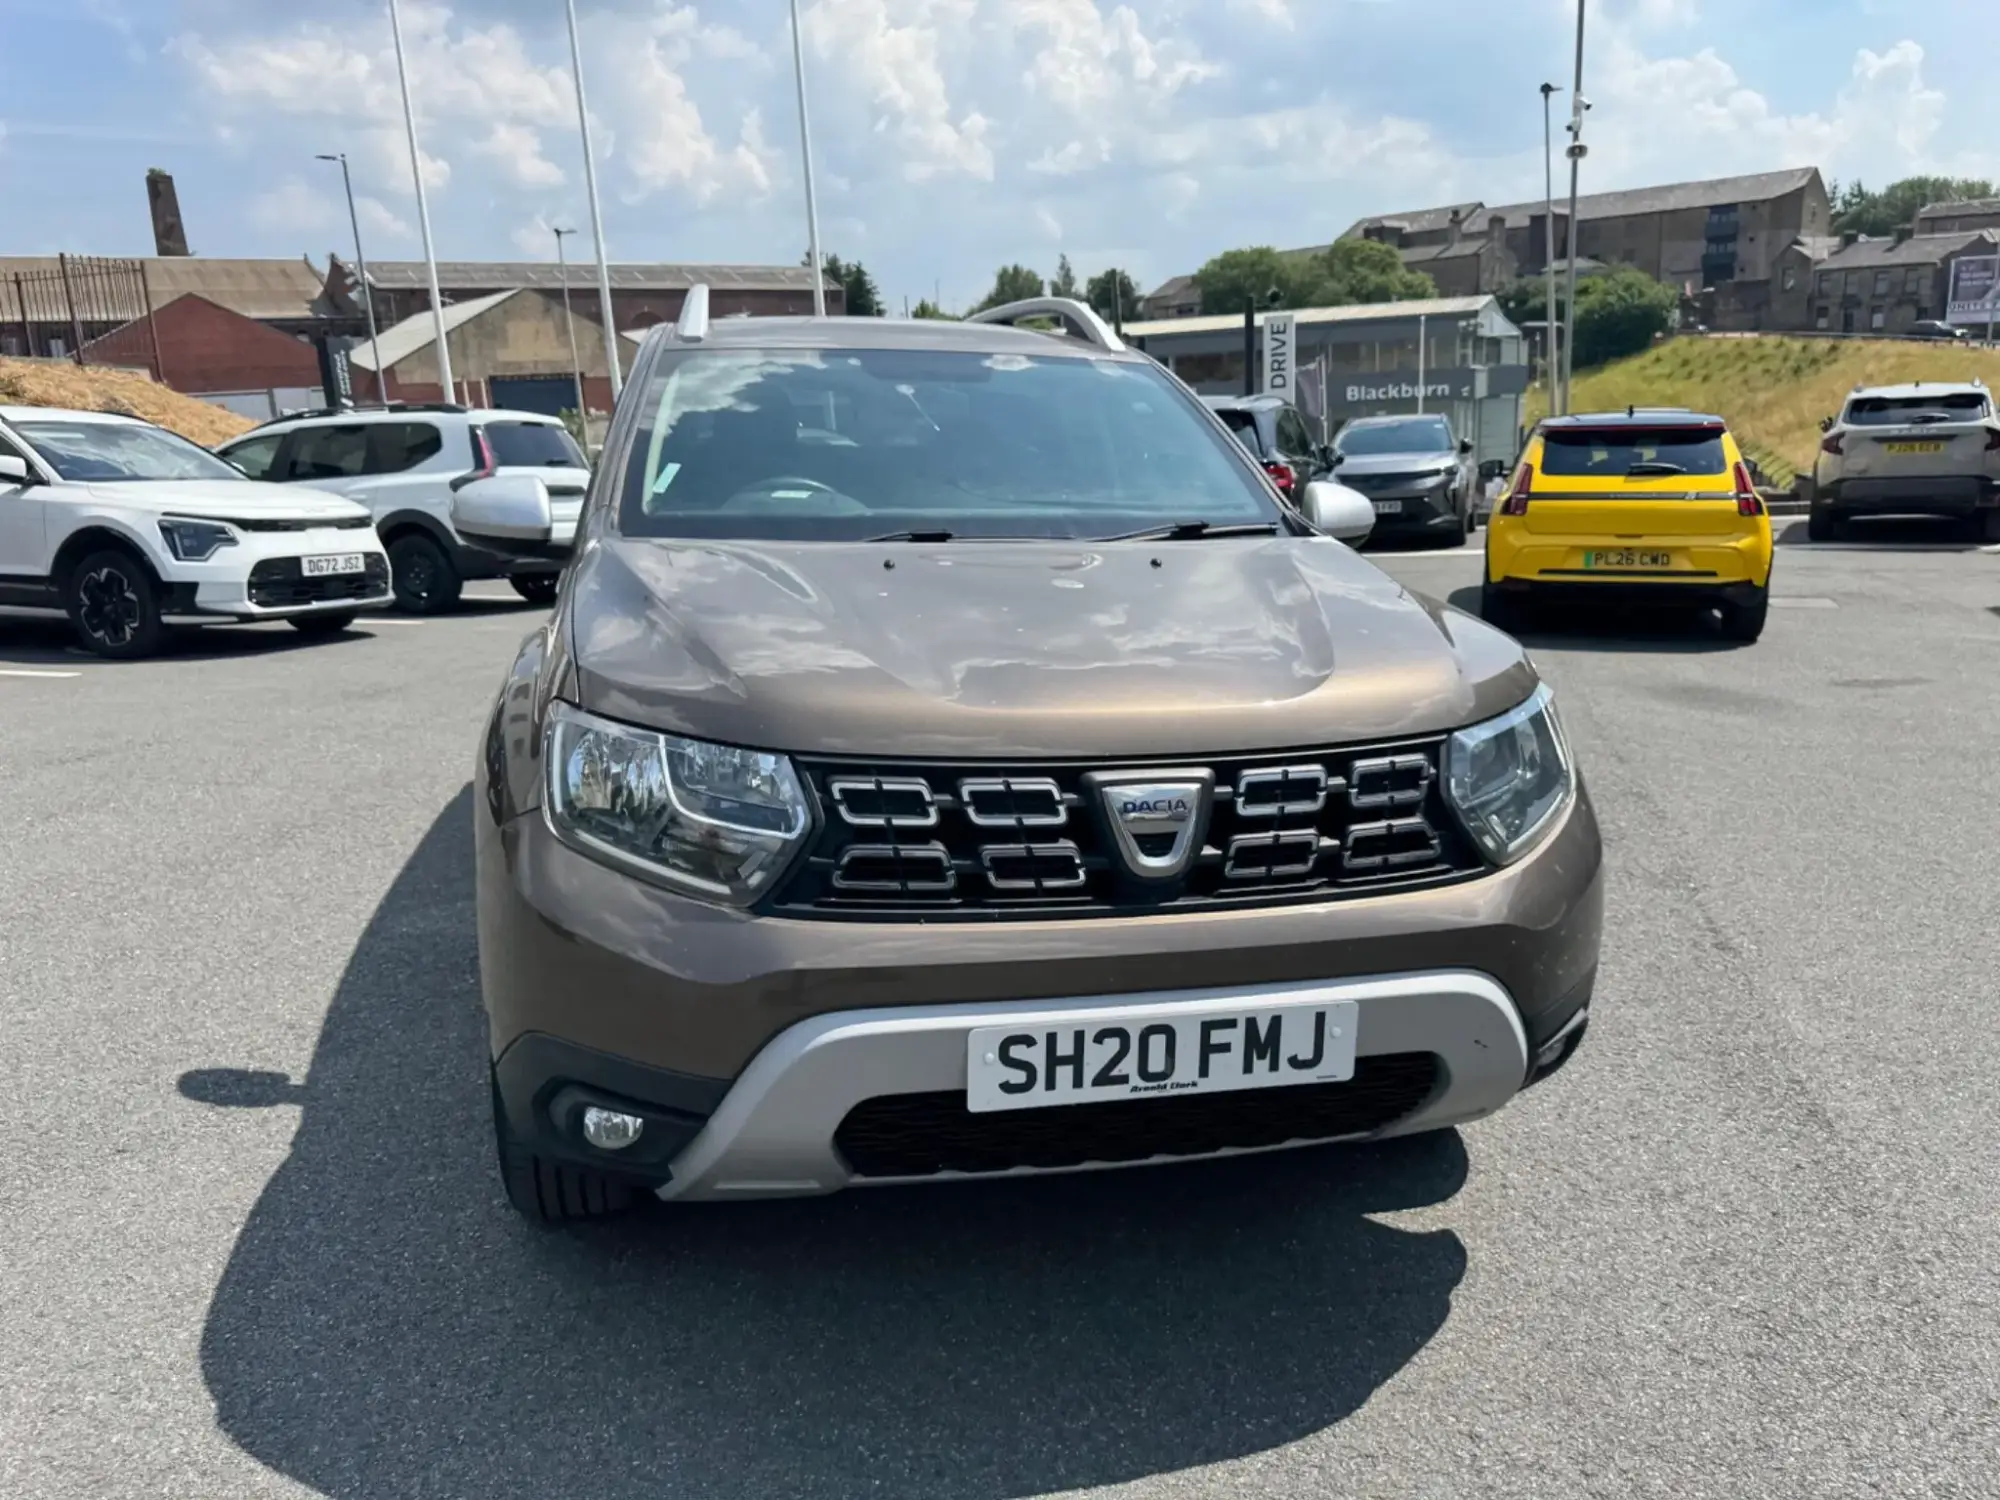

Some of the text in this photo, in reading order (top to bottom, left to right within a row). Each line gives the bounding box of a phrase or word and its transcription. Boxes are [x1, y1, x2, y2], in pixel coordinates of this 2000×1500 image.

[1270, 322, 1287, 390] DRIVE
[1346, 383, 1450, 401] Blackburn
[308, 558, 339, 573] DG72
[1594, 552, 1635, 566] PL26
[1122, 799, 1188, 814] DACIA
[998, 1011, 1327, 1095] SH20 FMJ
